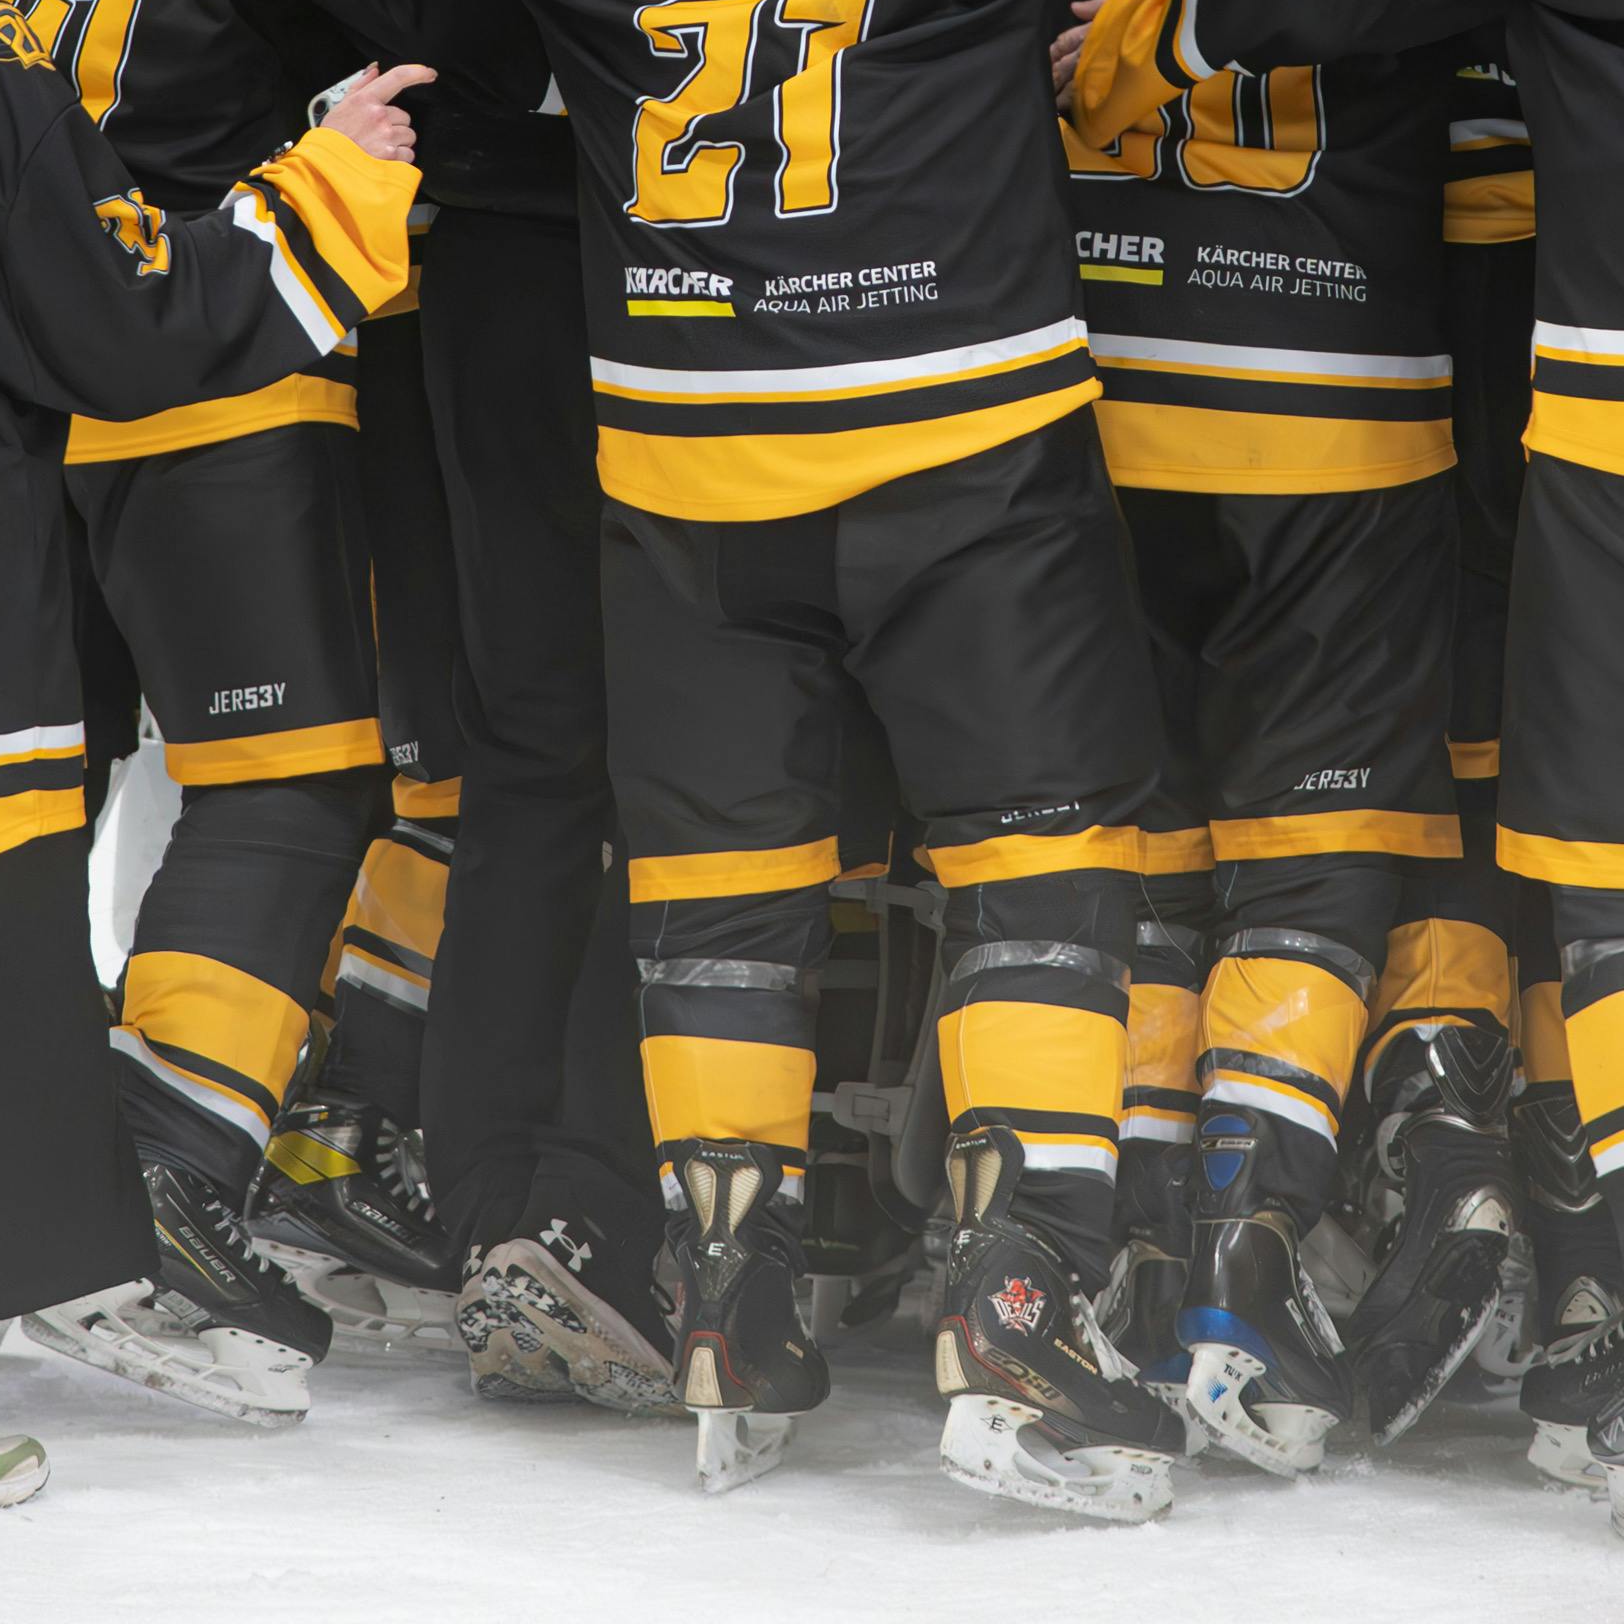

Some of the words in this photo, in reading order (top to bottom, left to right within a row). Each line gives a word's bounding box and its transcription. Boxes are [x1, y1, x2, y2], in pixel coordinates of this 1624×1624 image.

[765, 271, 854, 296] KÄRCHER
[859, 260, 938, 286] CENTER
[1196, 244, 1291, 271] KÄRCHER
[1295, 257, 1368, 280] CENTER
[625, 267, 734, 297] KÄRCHER
[753, 298, 811, 314] AQUA
[817, 295, 851, 314] AIR
[856, 282, 939, 310] JETTING
[1187, 268, 1244, 288] AQUA
[1250, 273, 1284, 293] AIR
[1290, 278, 1367, 302] JETTING
[209, 682, 286, 715] JER53Y
[1294, 767, 1371, 790] JER53Y
